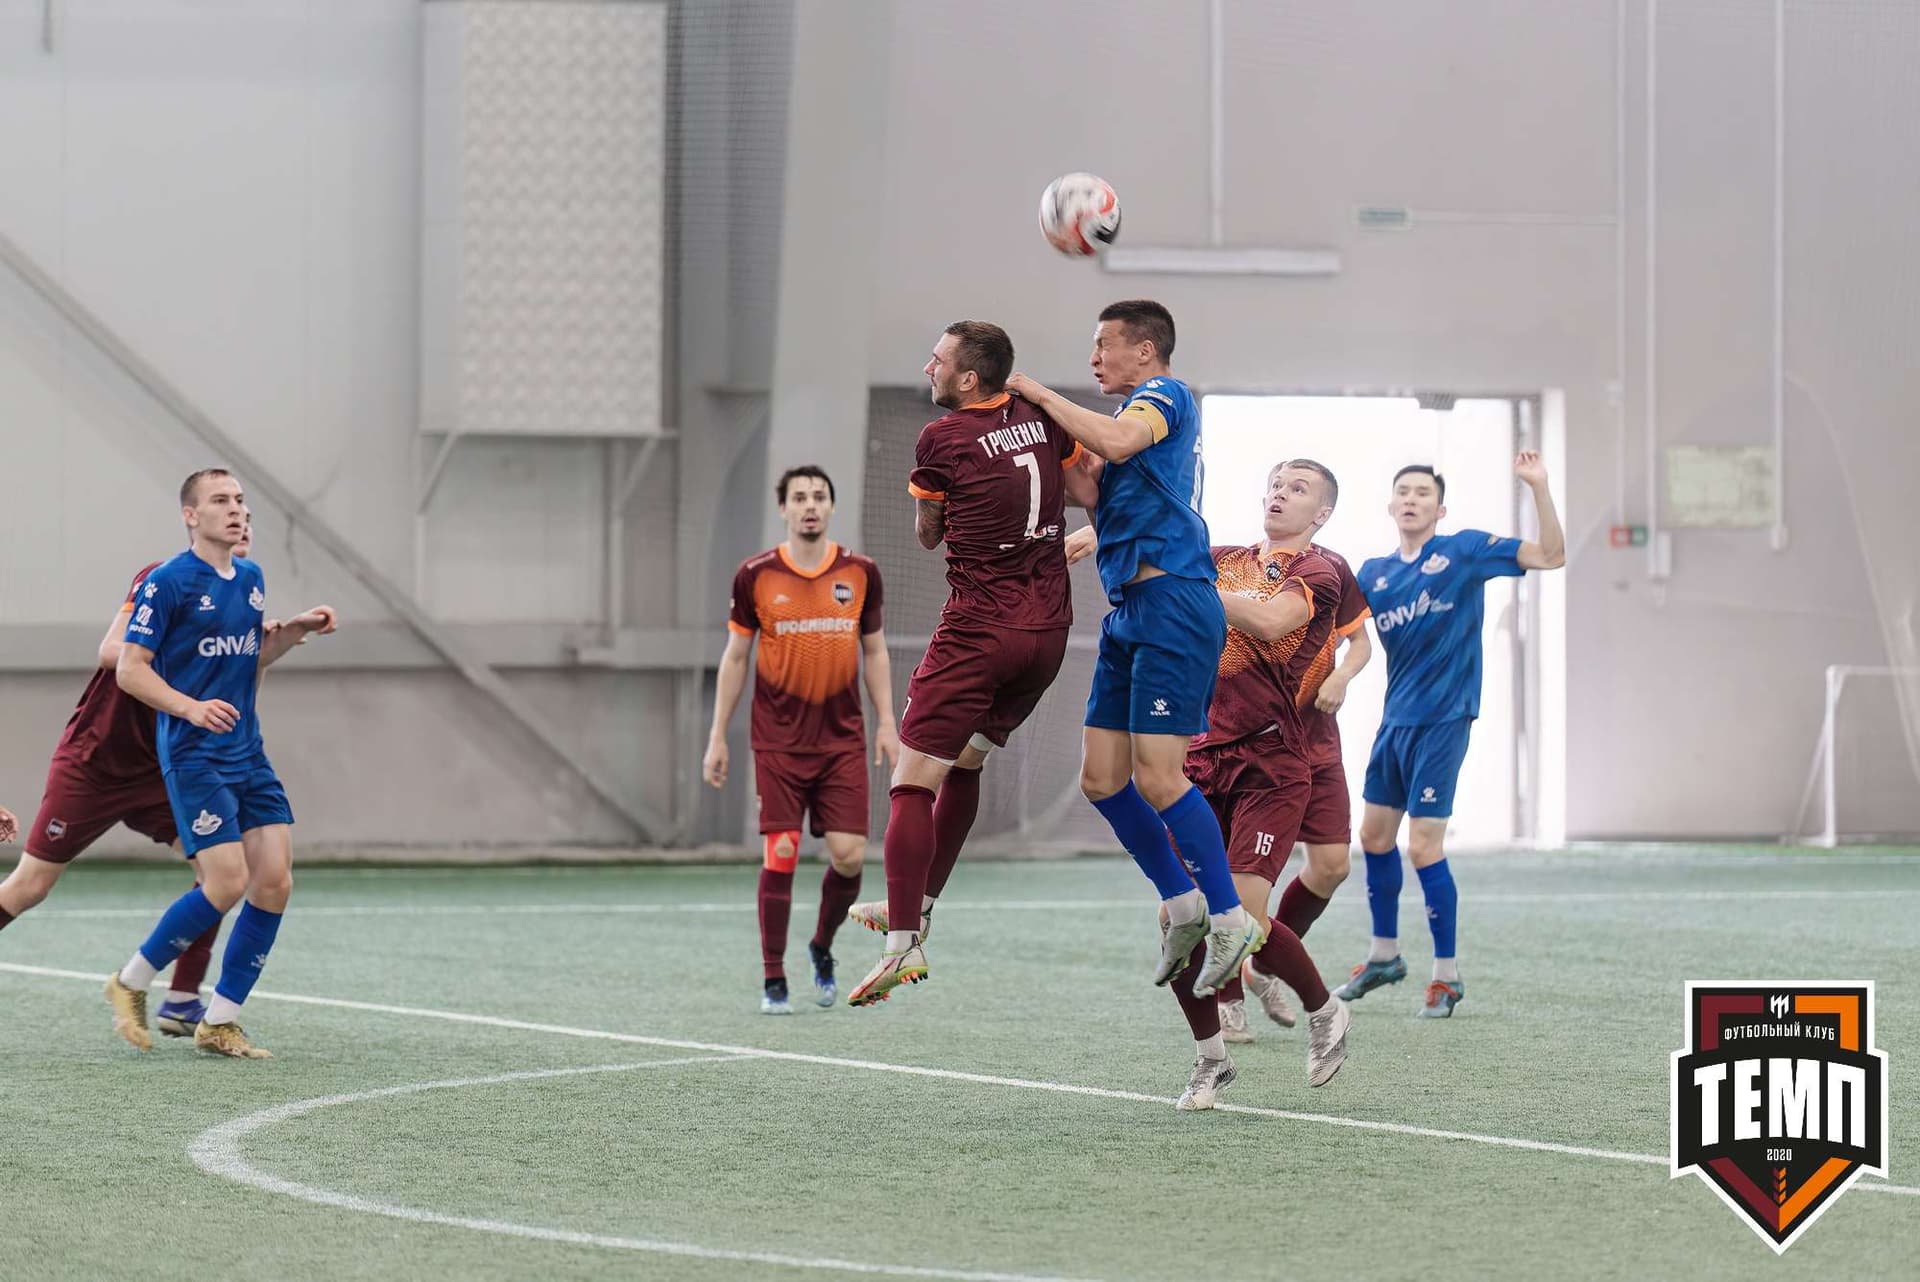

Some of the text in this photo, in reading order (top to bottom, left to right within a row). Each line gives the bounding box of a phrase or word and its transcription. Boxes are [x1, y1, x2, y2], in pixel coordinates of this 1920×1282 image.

[977, 421, 1047, 458] ТРОЦЕНКО
[198, 636, 244, 657] GNV
[1254, 831, 1275, 857] 15
